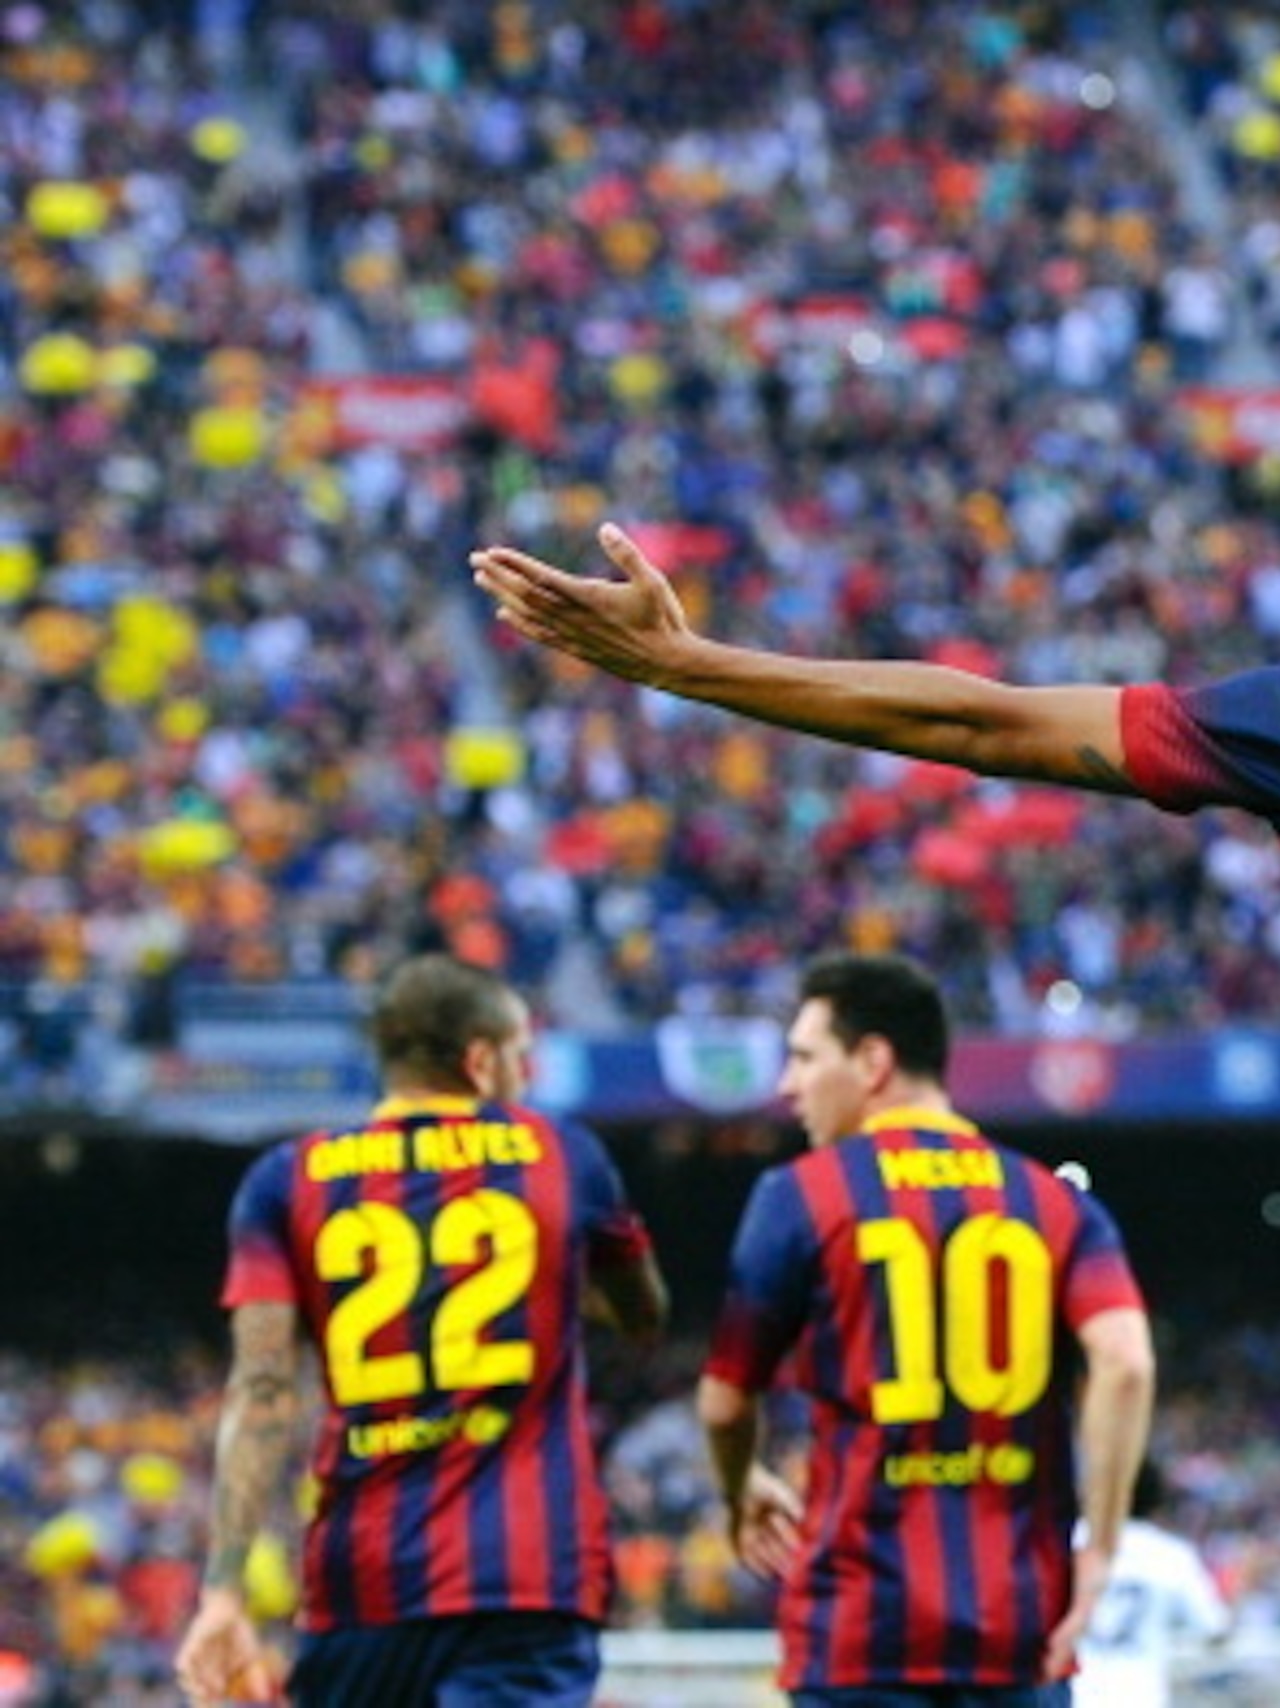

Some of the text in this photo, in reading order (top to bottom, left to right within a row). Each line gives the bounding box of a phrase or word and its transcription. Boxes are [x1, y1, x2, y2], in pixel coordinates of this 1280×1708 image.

[306, 1122, 541, 1182] DANI ALVES
[878, 1149, 1003, 1190] MESSI
[314, 1187, 538, 1406] 22
[856, 1214, 1053, 1424] 10
